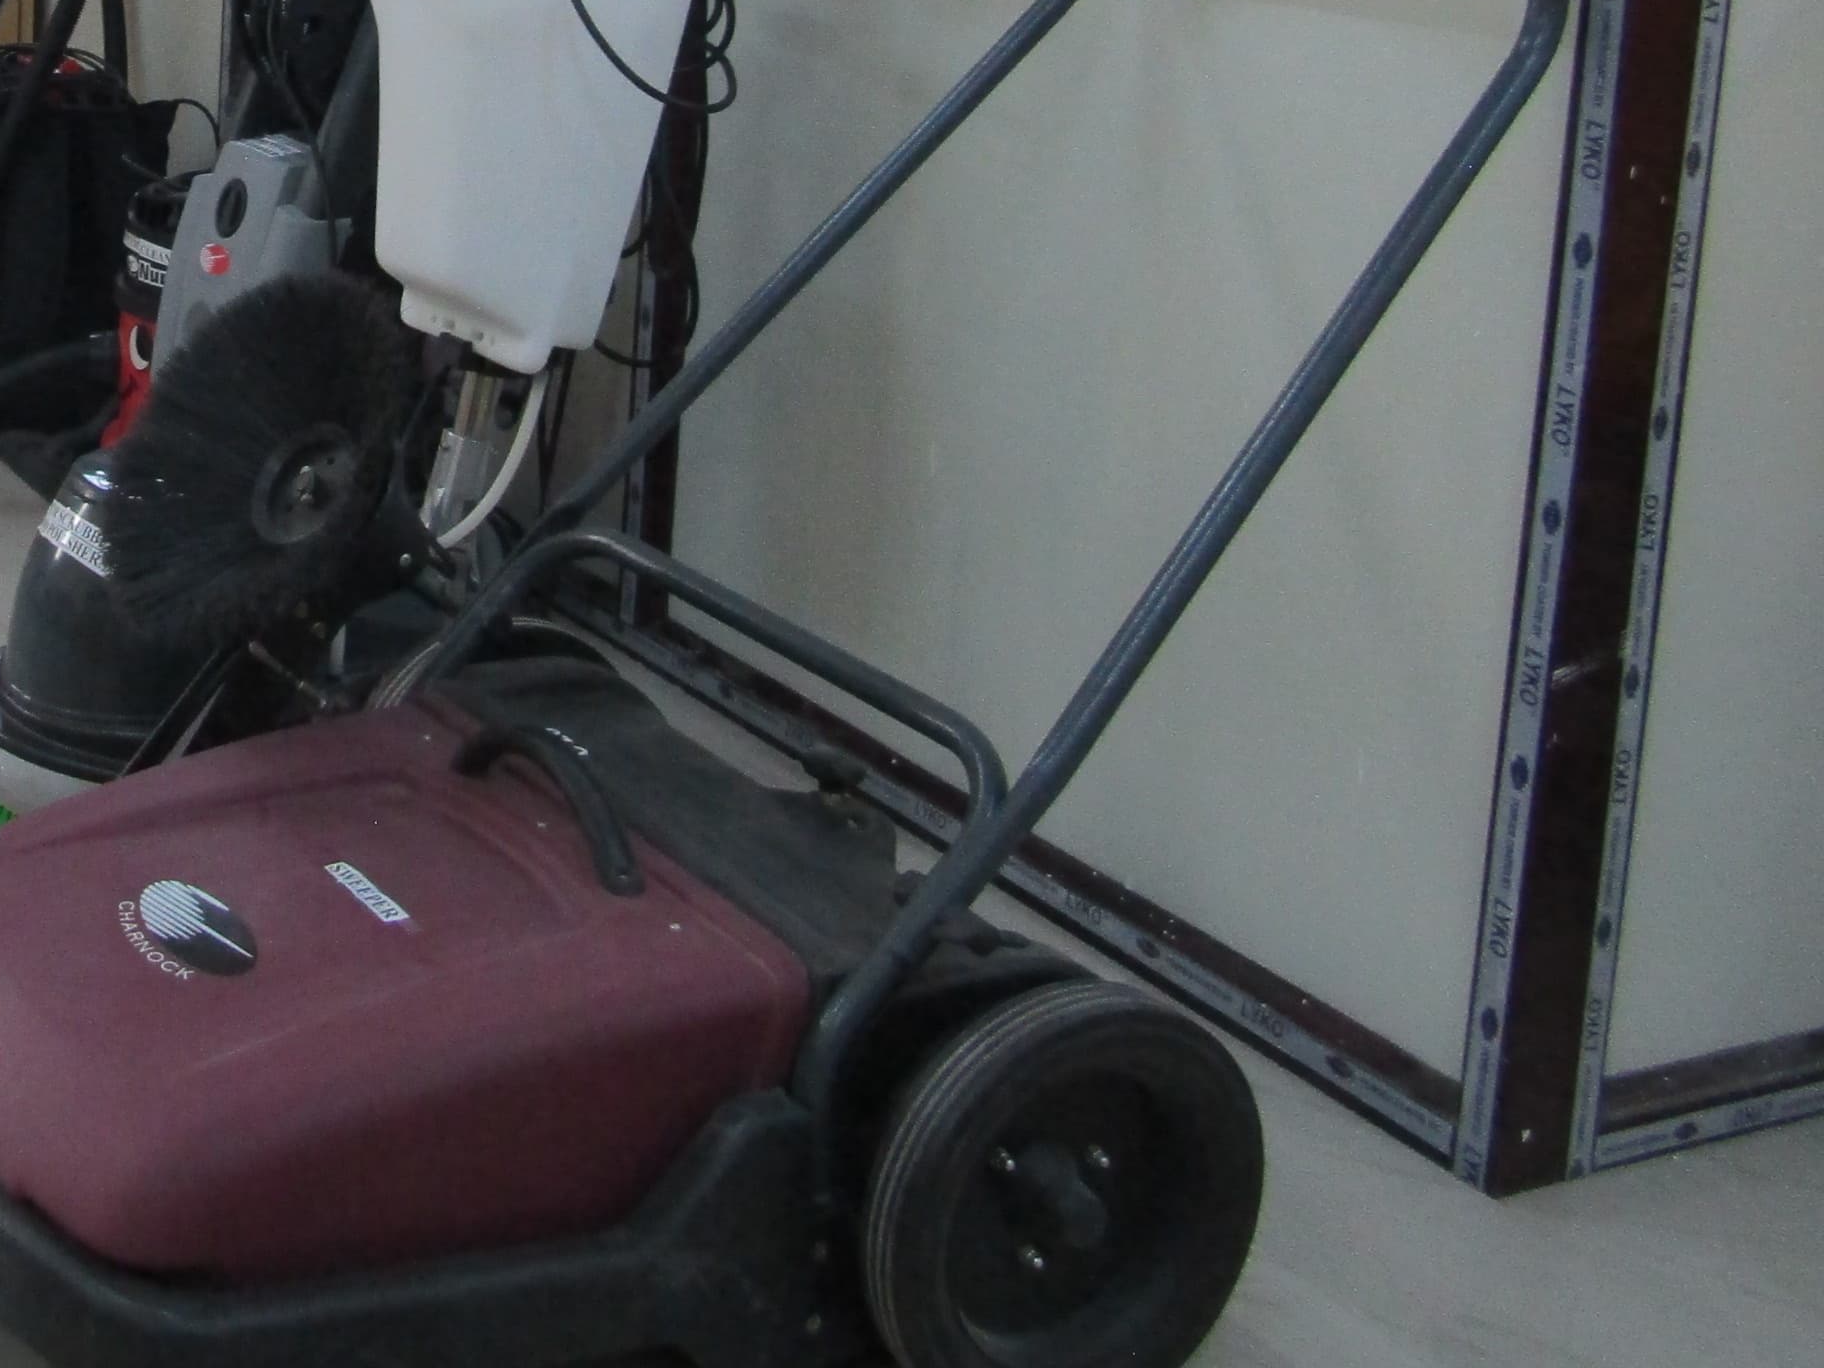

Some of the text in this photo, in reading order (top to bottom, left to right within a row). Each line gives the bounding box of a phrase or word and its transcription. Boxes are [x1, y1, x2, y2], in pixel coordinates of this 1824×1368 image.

[1582, 120, 1606, 180] LYKO
[1551, 386, 1575, 447] LYKO
[1640, 494, 1659, 551] LYKO
[1520, 649, 1544, 707] LYKO
[332, 863, 397, 920] SWEEPER
[118, 900, 195, 980] CHARNOCK
[1489, 899, 1513, 959] LYKO
